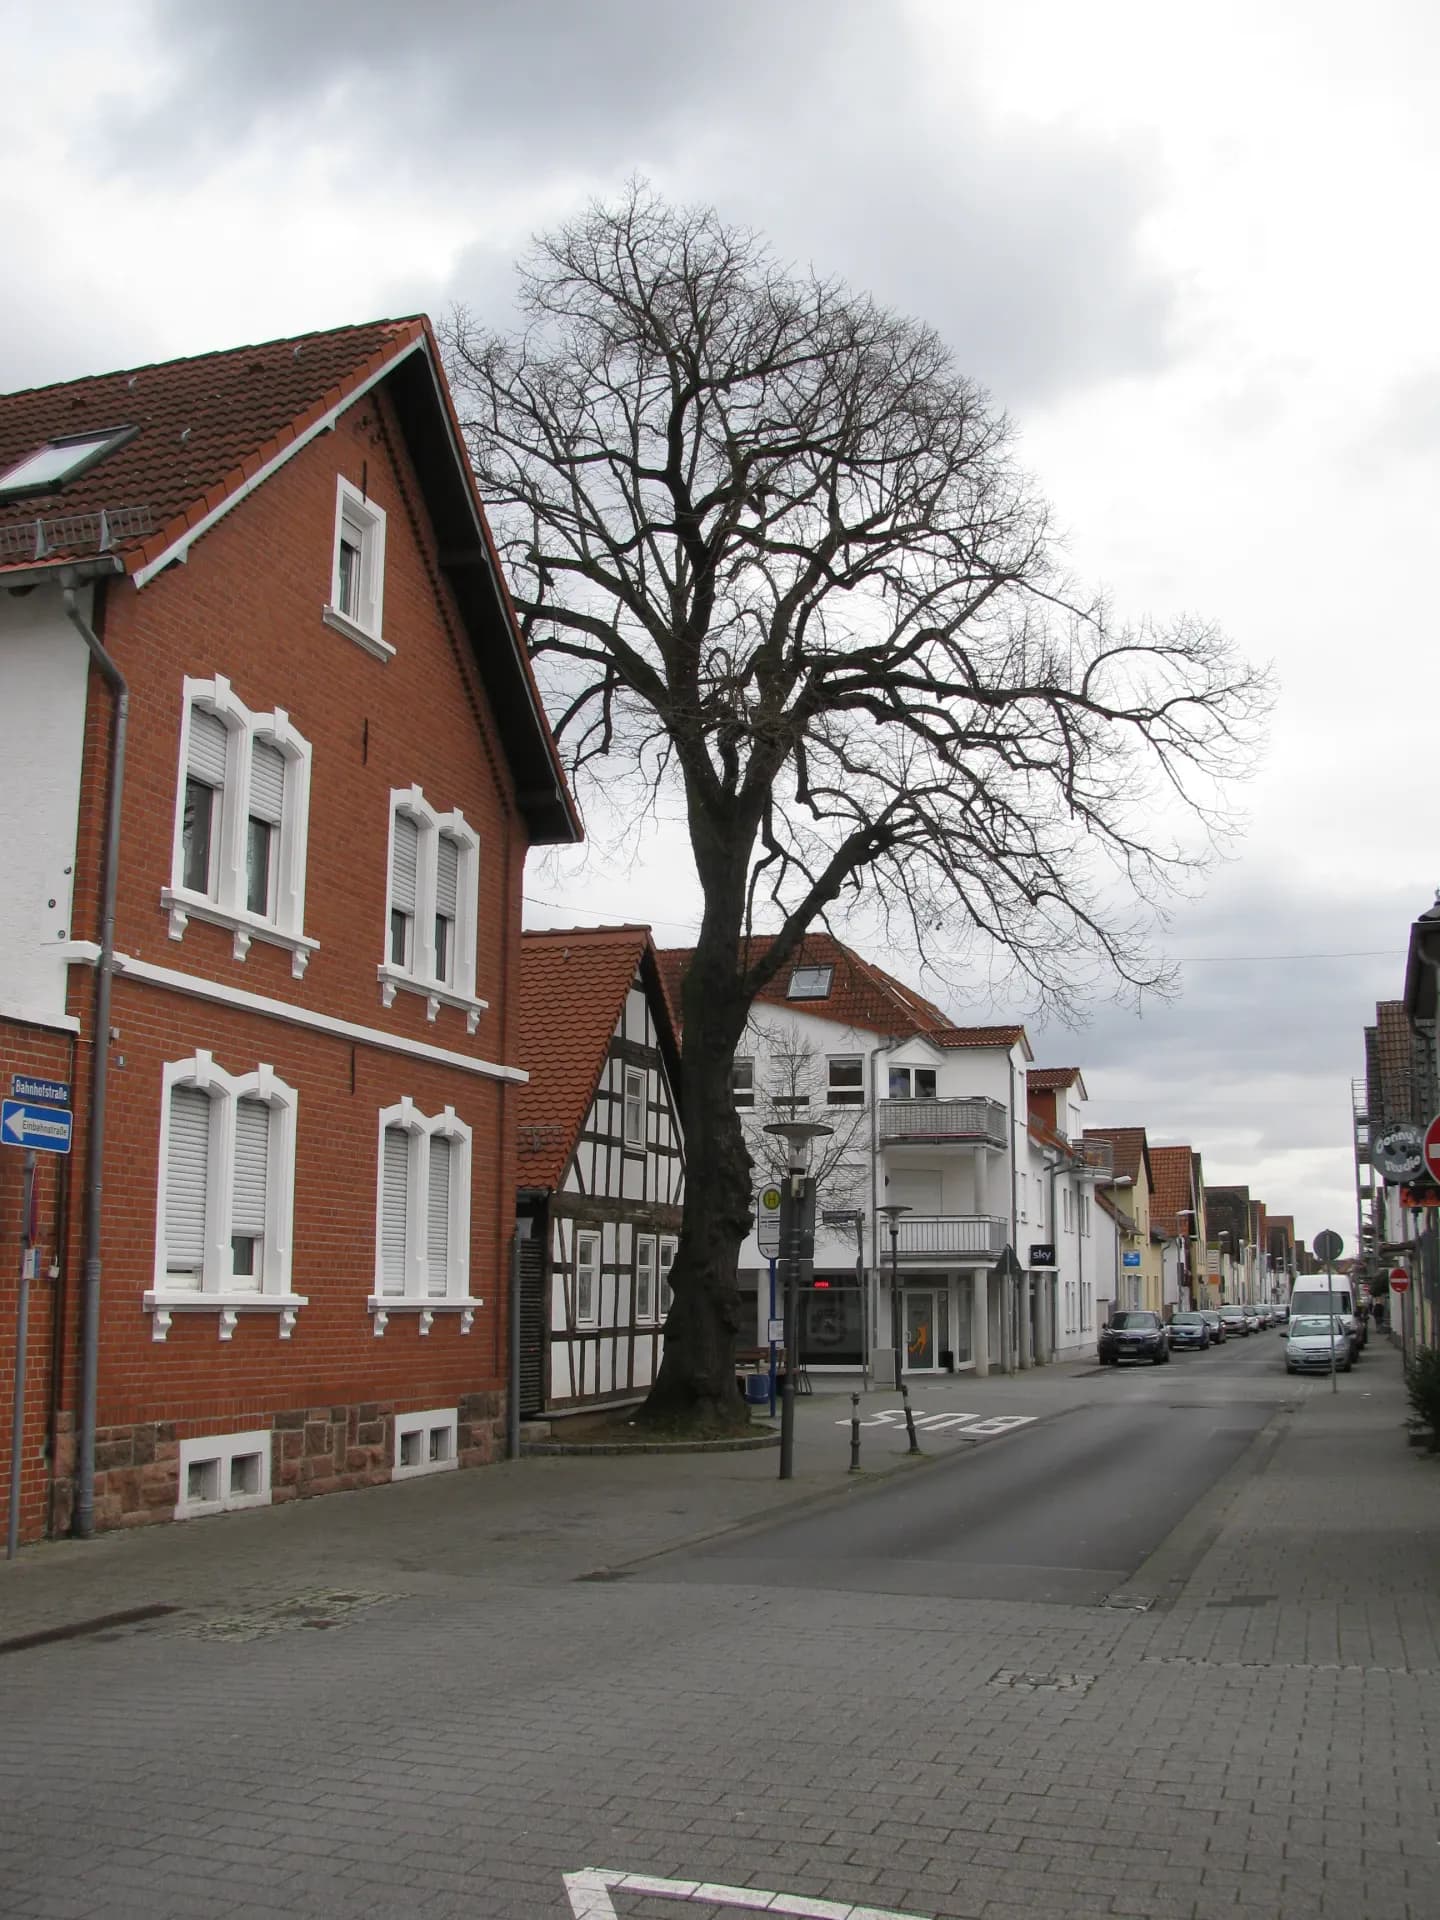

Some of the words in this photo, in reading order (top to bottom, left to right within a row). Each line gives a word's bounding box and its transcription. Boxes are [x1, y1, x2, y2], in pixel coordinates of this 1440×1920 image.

[16, 1079, 67, 1101] Bahnhofstraße
[22, 1119, 67, 1136] Einbahnstraße
[1032, 1249, 1052, 1261] sky
[834, 1409, 1040, 1435] BUS
